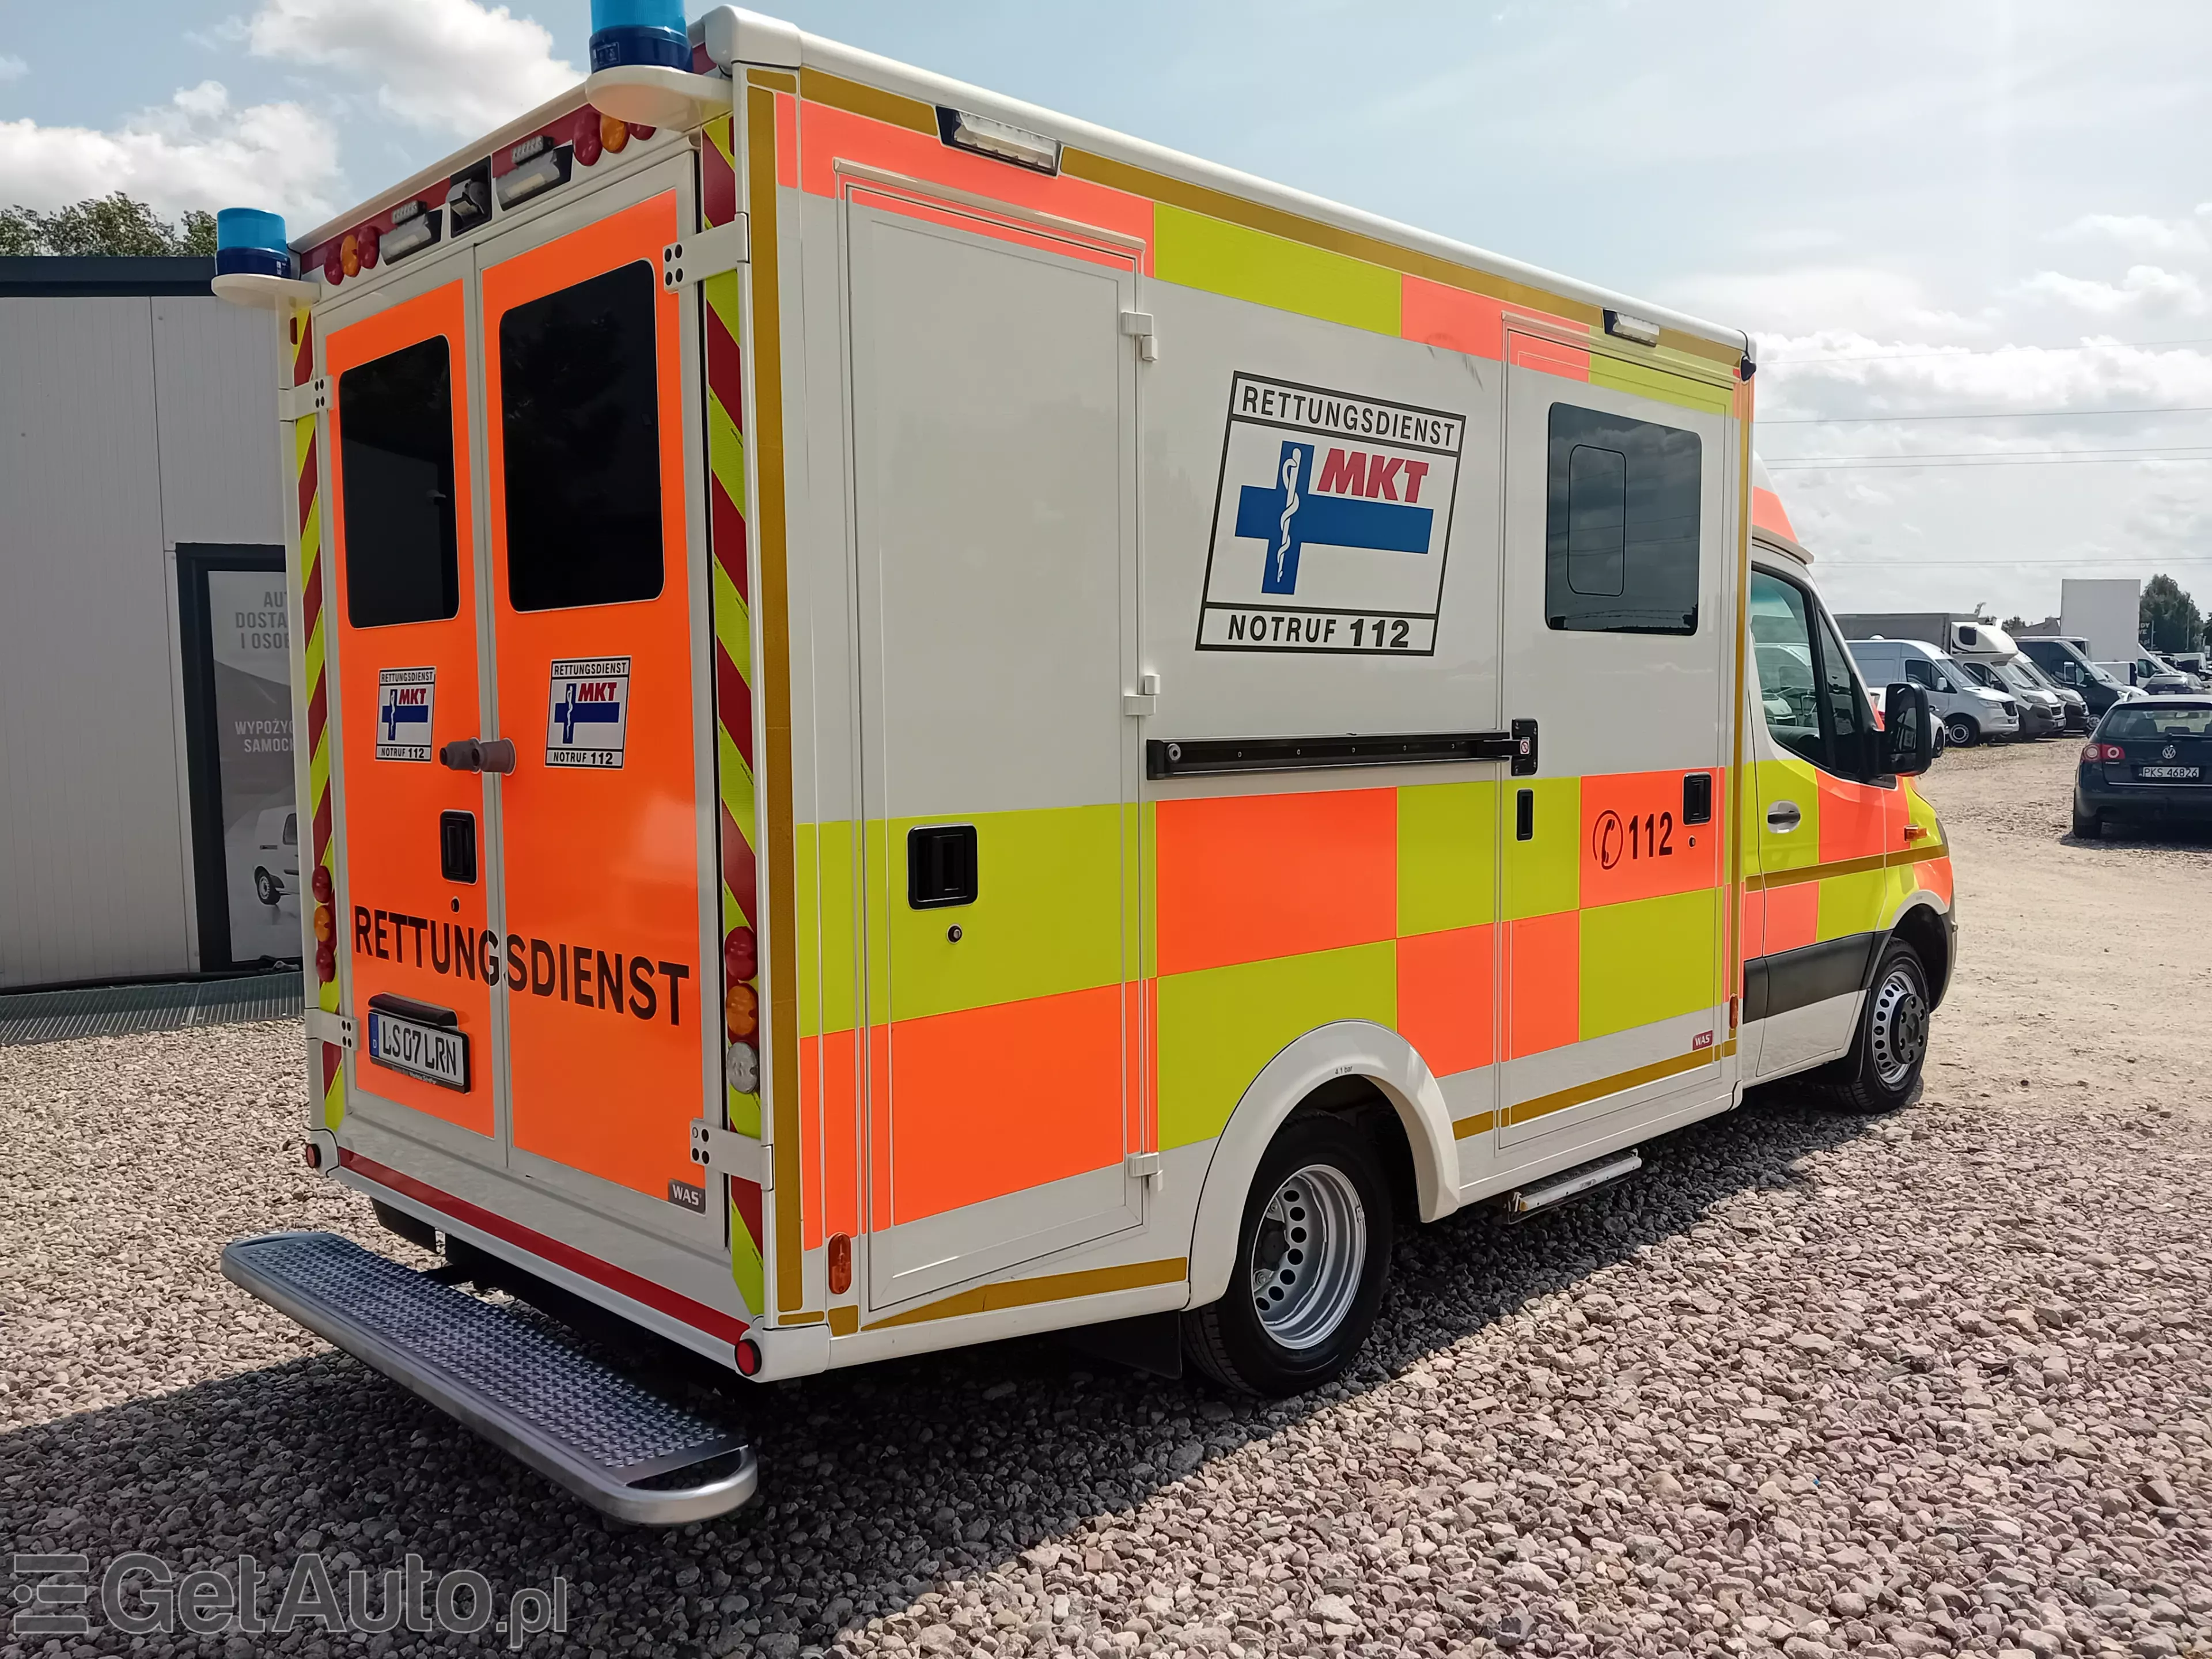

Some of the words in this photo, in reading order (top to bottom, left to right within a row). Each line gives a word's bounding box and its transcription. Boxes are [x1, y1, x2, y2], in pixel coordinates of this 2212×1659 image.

[1242, 385, 1455, 446] RETTUNGSDIENST
[1317, 448, 1429, 503] MKT
[1228, 615, 1336, 643] NOTRUF
[1350, 619, 1410, 647] 112
[381, 672, 433, 682] RETTUNGSDIENST
[554, 662, 626, 675] RETTUNGSDIENST
[399, 688, 426, 704] MKT
[578, 682, 617, 701] MKT
[381, 748, 405, 757] NOTRUF
[408, 748, 424, 758] 112
[554, 752, 586, 762] NOTRUF
[590, 752, 613, 764] 112
[2144, 768, 2162, 777] PKS
[1629, 812, 1672, 859] 112
[354, 905, 689, 1025] RETTUNGSDIENST
[1695, 1035, 1710, 1046] WAS
[672, 1184, 699, 1206] WAS
